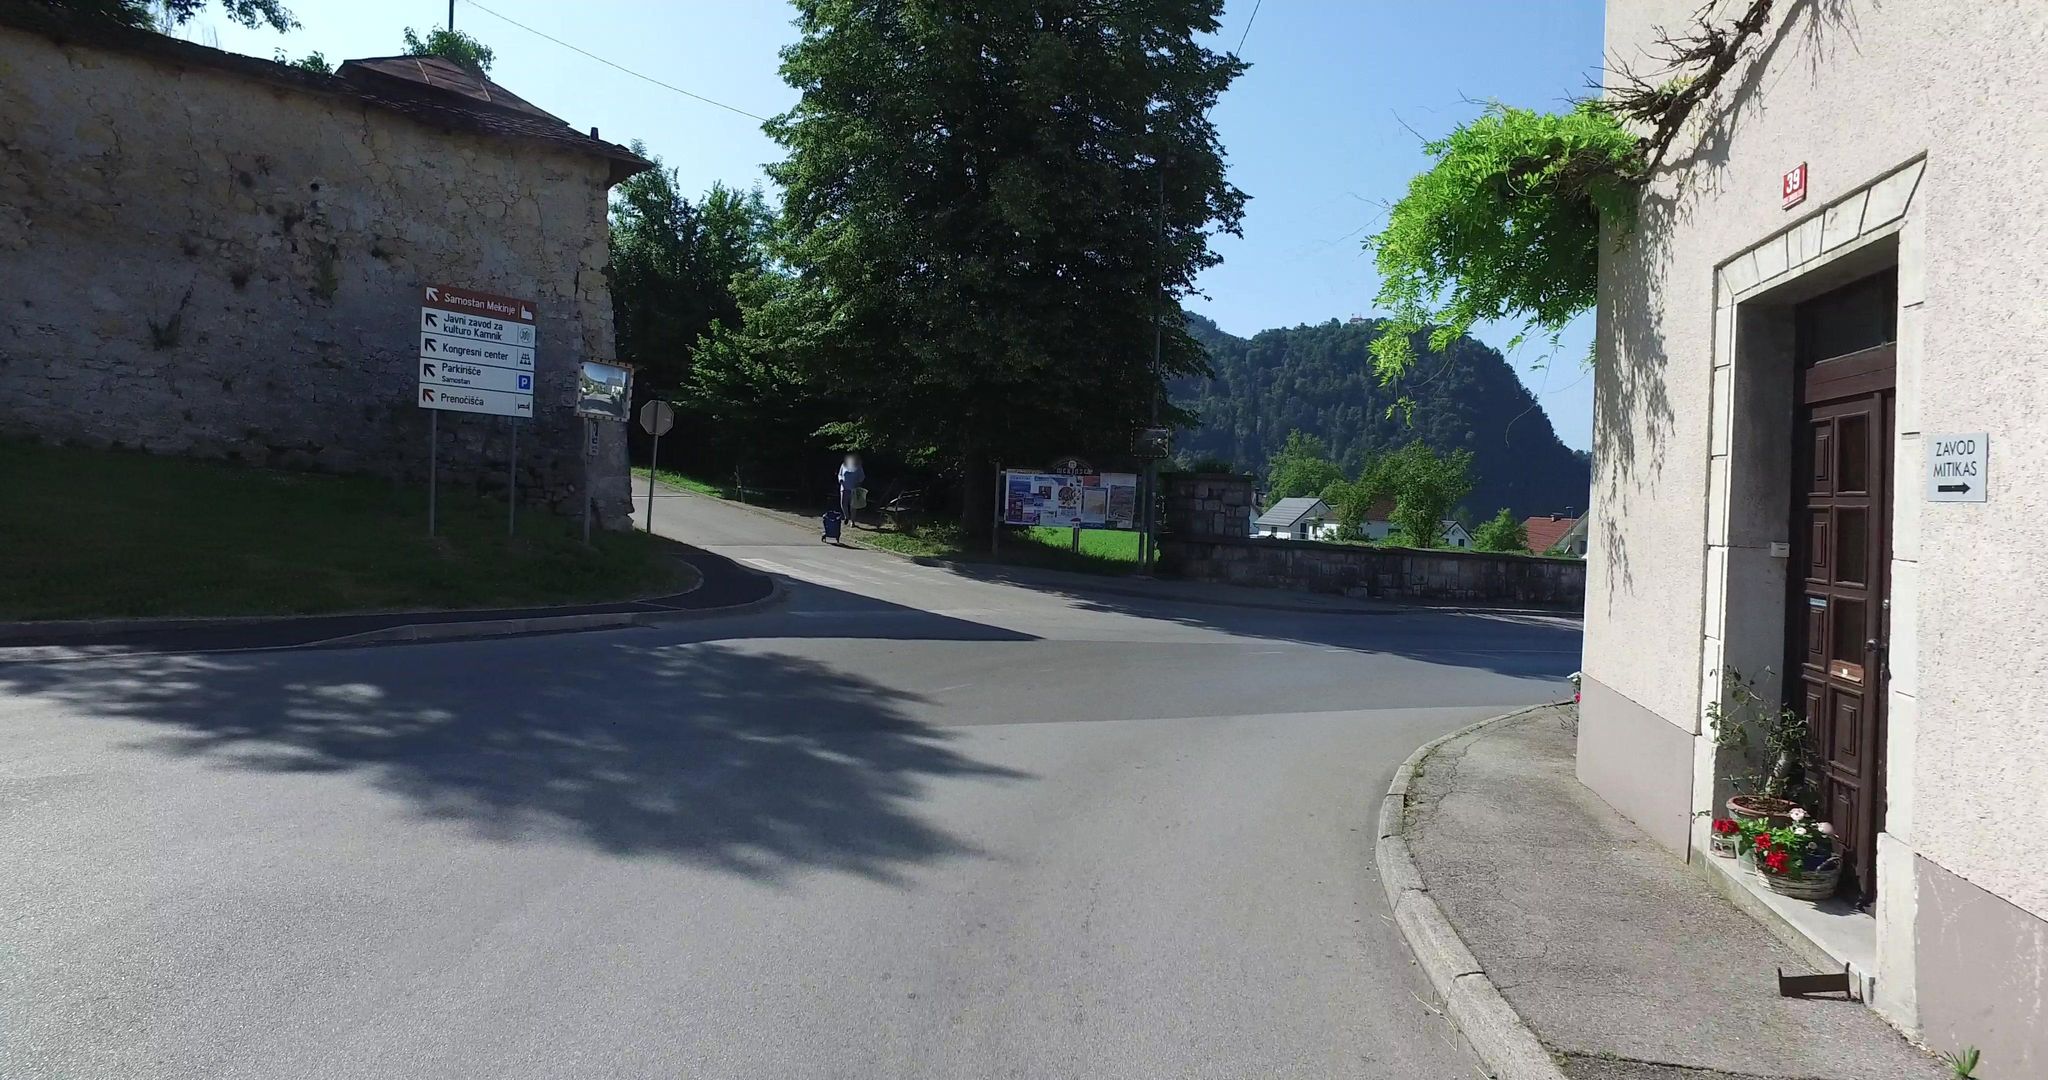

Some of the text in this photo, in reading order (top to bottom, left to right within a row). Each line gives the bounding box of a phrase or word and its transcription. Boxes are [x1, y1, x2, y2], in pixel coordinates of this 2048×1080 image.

[1786, 168, 1800, 194] 39
[444, 292, 516, 315] Samostan Mekinje
[443, 313, 503, 331] Javni zavod za
[443, 324, 502, 341] kulturo Kamnik
[442, 343, 509, 360] Kongresni center
[442, 362, 482, 376] Parkirišče
[441, 375, 471, 385] Samostan
[440, 393, 484, 406] Prenočišča
[1936, 440, 1976, 457] ZAVOD
[1933, 460, 1977, 477] MITIKAS
